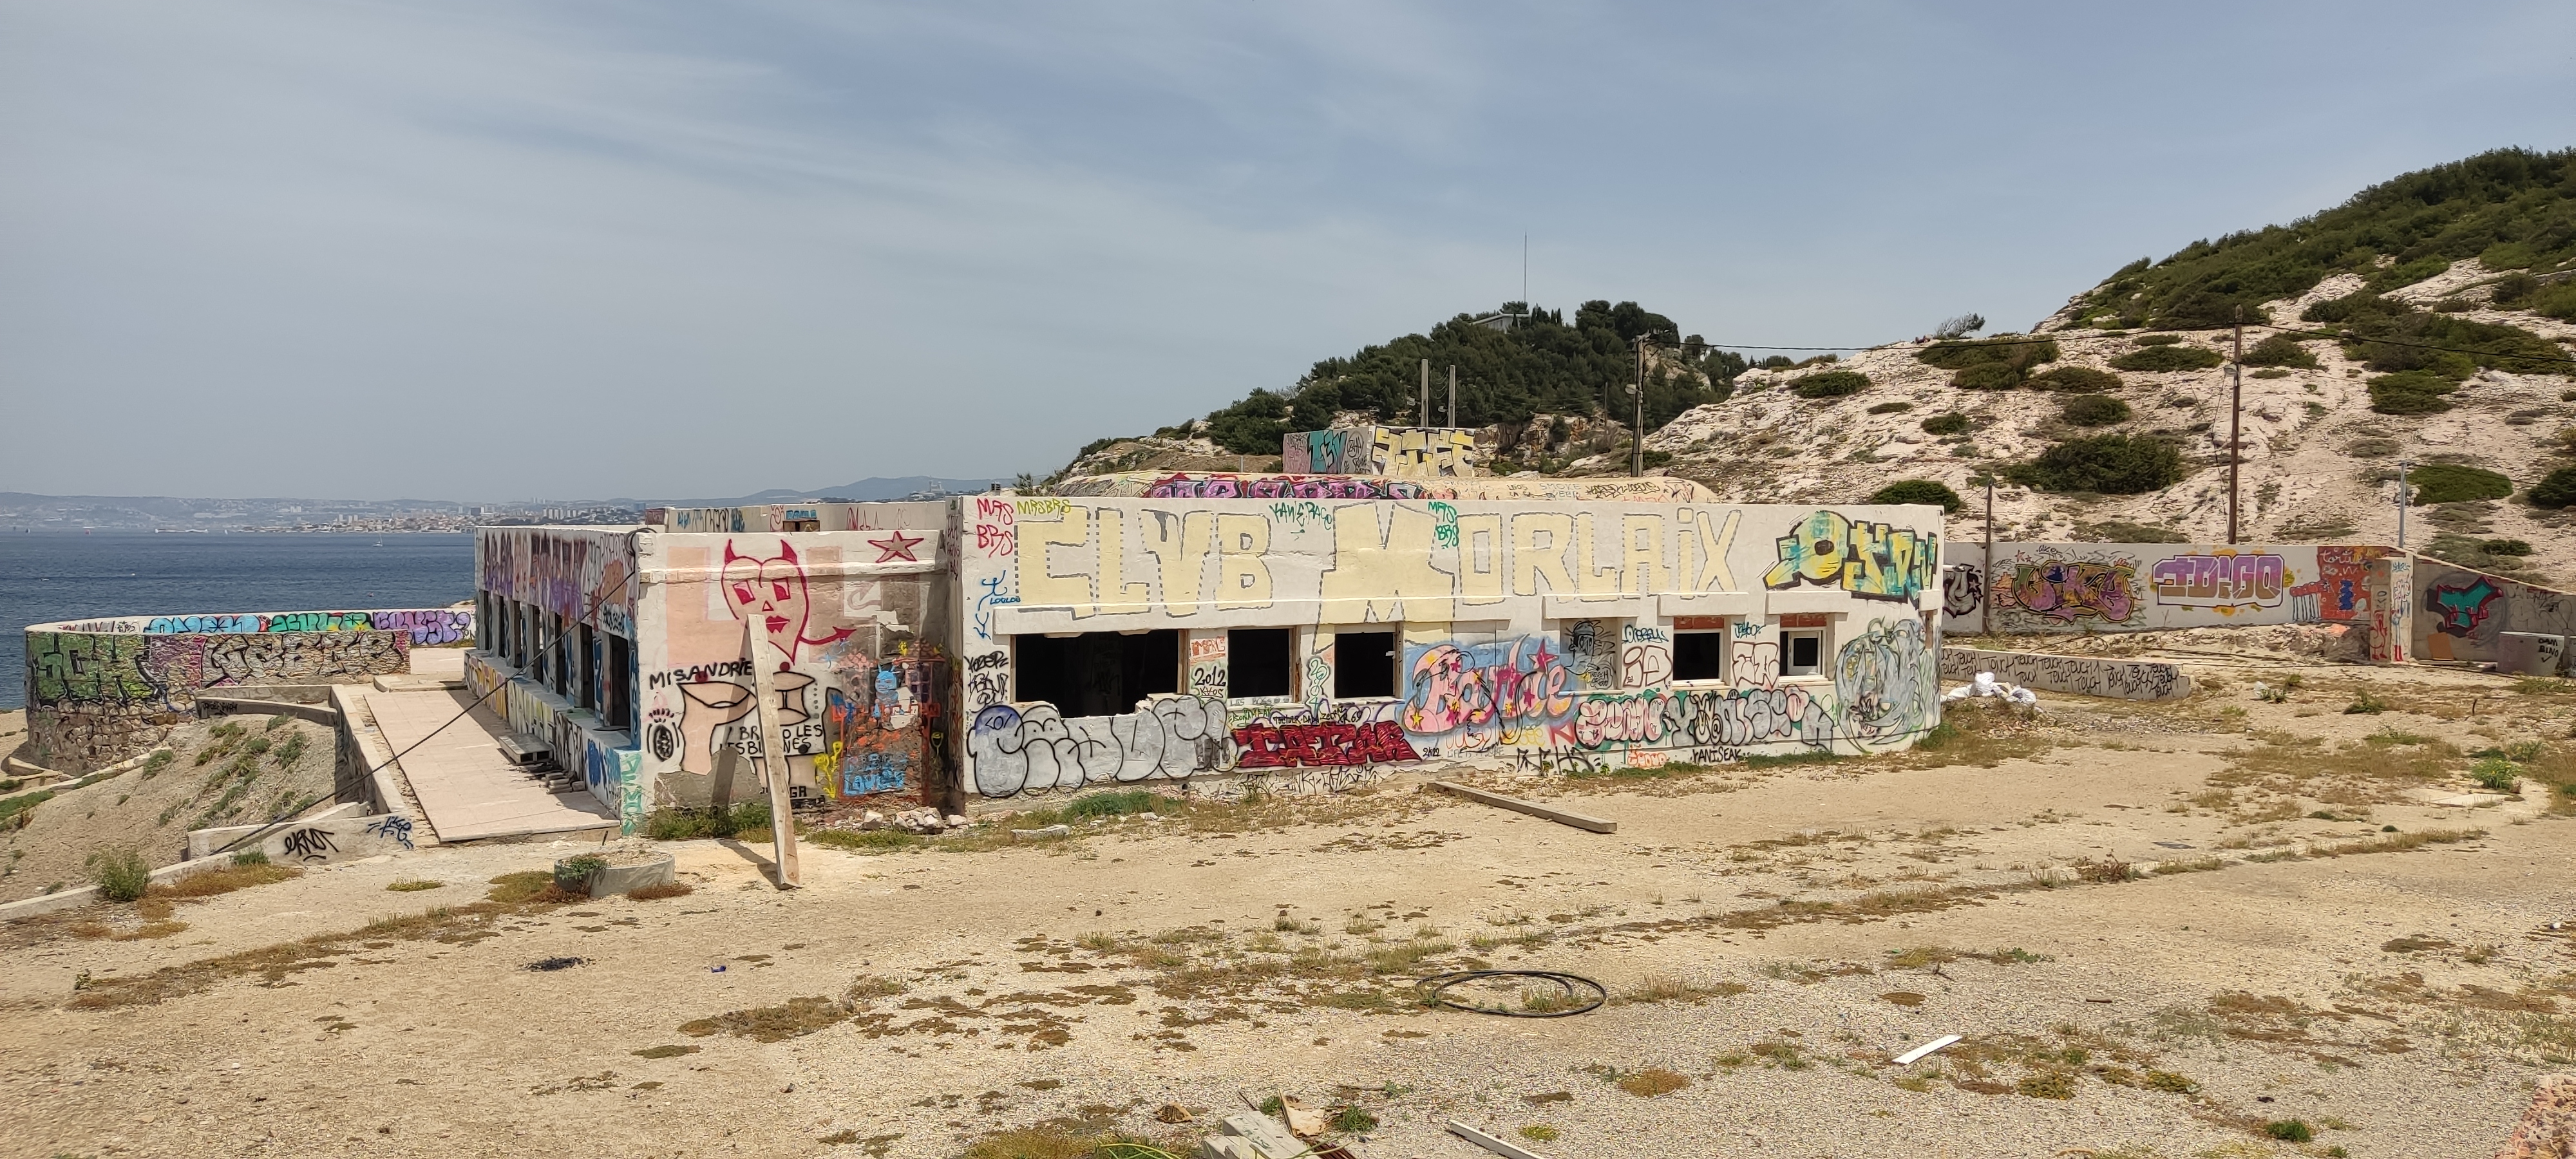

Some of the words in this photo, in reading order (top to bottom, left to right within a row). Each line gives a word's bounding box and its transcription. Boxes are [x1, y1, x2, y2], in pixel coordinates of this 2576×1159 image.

[977, 498, 1014, 525] MRS
[976, 524, 1014, 559] BRS
[649, 657, 753, 690] MISANDRIE
[1195, 665, 1227, 686] 2012
[796, 724, 824, 739] LES
[1692, 746, 1741, 764] YANISEAK
